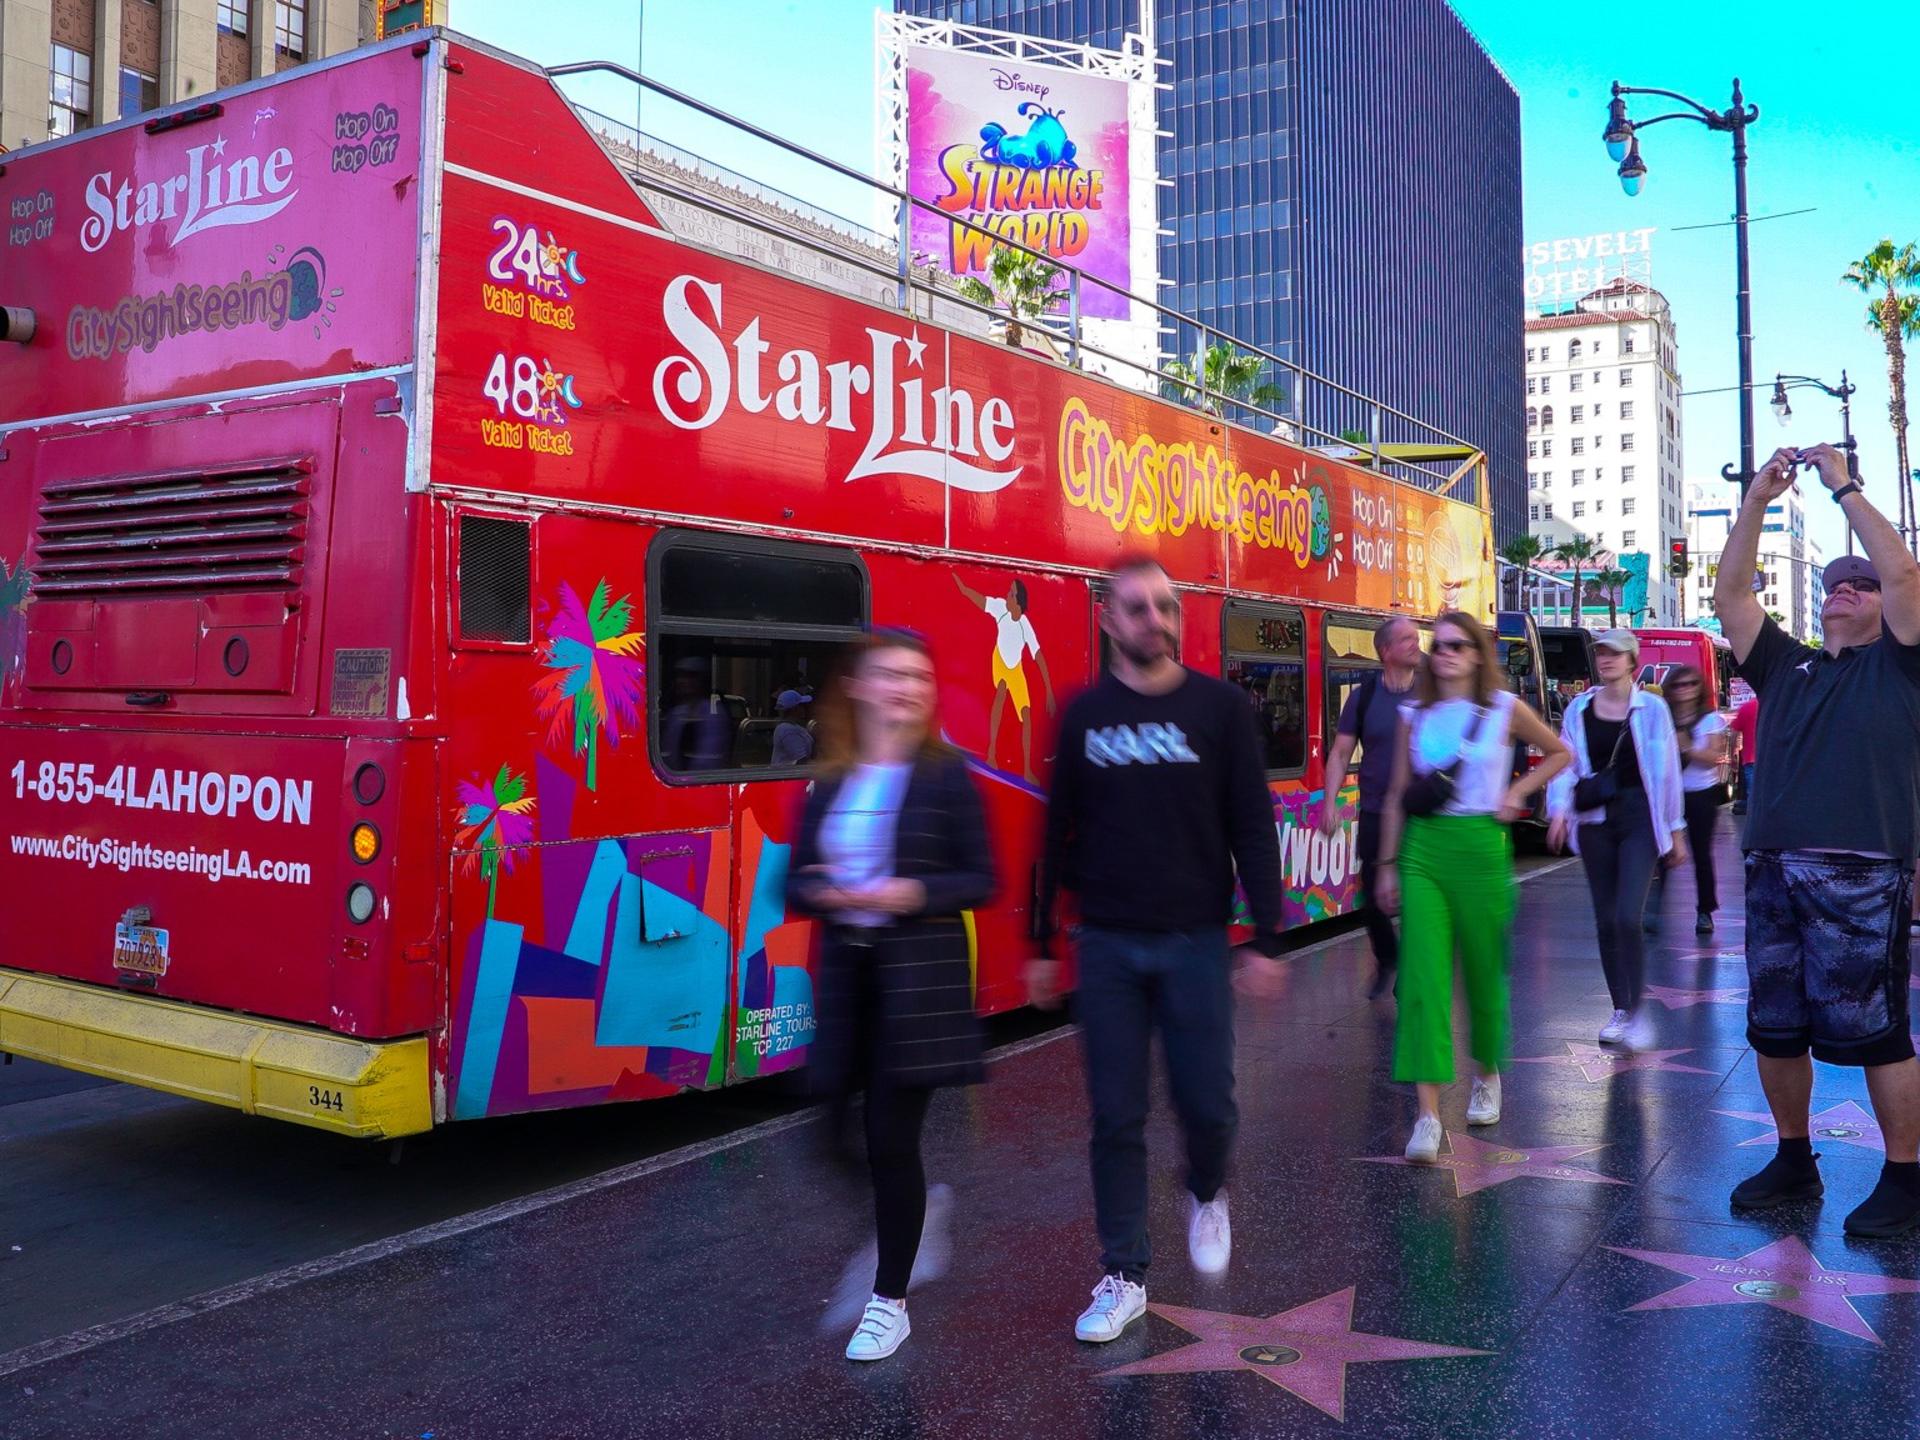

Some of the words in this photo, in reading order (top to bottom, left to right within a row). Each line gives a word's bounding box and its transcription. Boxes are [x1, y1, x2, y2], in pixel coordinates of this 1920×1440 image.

[336, 113, 369, 139] Hop
[373, 106, 397, 132] On
[333, 146, 366, 172] Hop
[370, 136, 398, 166] Off
[935, 144, 1104, 211] STRANGE
[11, 199, 34, 219] Hop
[37, 191, 54, 212] On
[9, 227, 32, 246] Hop
[488, 218, 542, 287] 24
[483, 283, 525, 318] Valid
[527, 294, 576, 331] Ticket
[483, 353, 540, 417] 48
[481, 418, 523, 450] Valid
[526, 424, 574, 456] Ticket
[1352, 488, 1376, 527] Hop
[1378, 495, 1393, 530] On
[1352, 532, 1375, 570] Hop
[1377, 538, 1393, 570] Off
[340, 657, 384, 672] CAUTION
[11, 759, 313, 825] 1-855-4LAHOPON
[11, 834, 311, 885] www.CitySightseeingLA.com
[736, 1021, 782, 1043] STARLINE
[746, 1005, 794, 1024] OPERATED
[753, 1040, 772, 1056] TCP
[776, 1036, 794, 1052] 227
[309, 1085, 343, 1112] 344
[1707, 1263, 1777, 1278] JERRY
